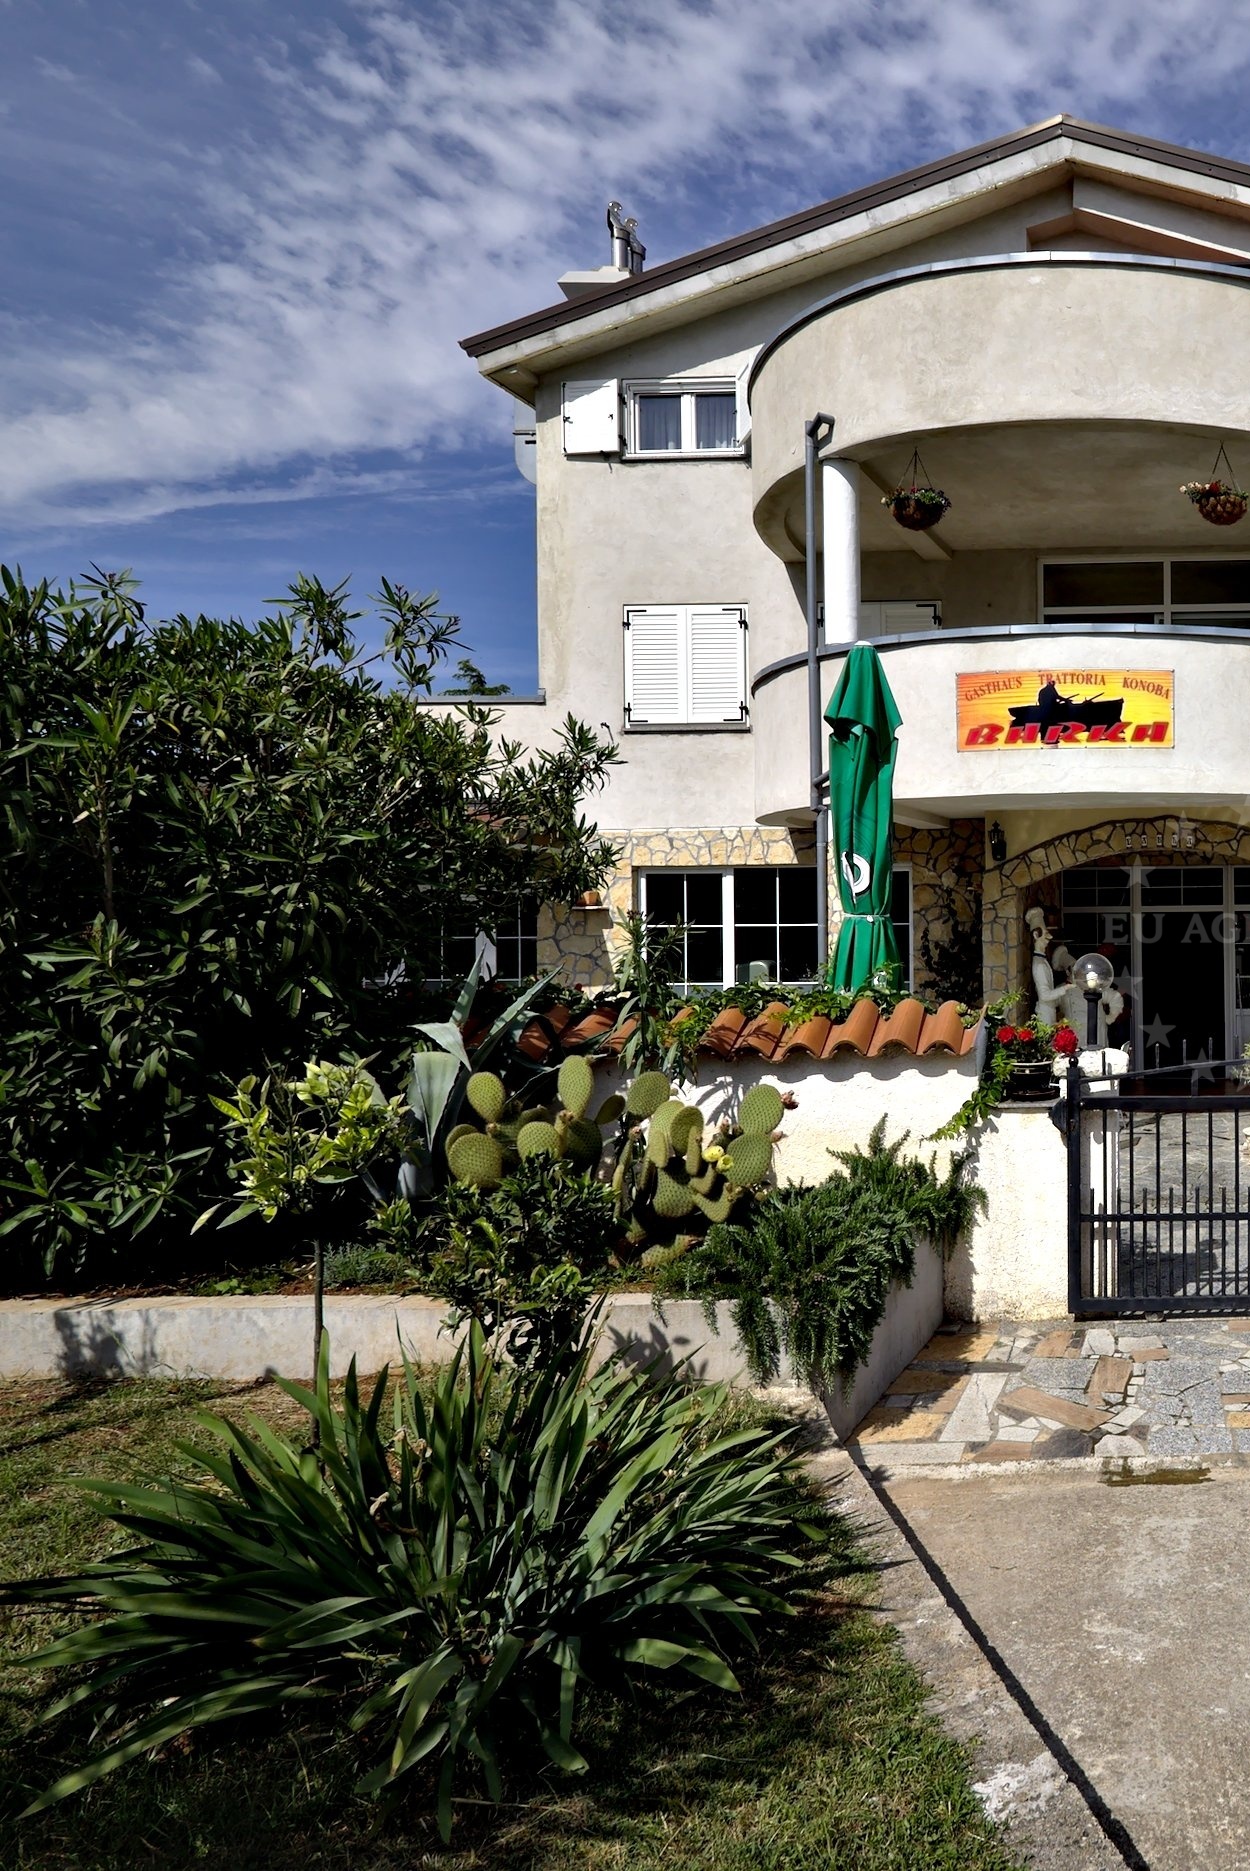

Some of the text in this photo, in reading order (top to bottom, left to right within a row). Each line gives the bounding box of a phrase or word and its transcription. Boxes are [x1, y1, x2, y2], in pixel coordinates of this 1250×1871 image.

[965, 672, 1170, 702] GASTHAUS TRATTORIA KONOBA
[965, 721, 1169, 746] BARKA
